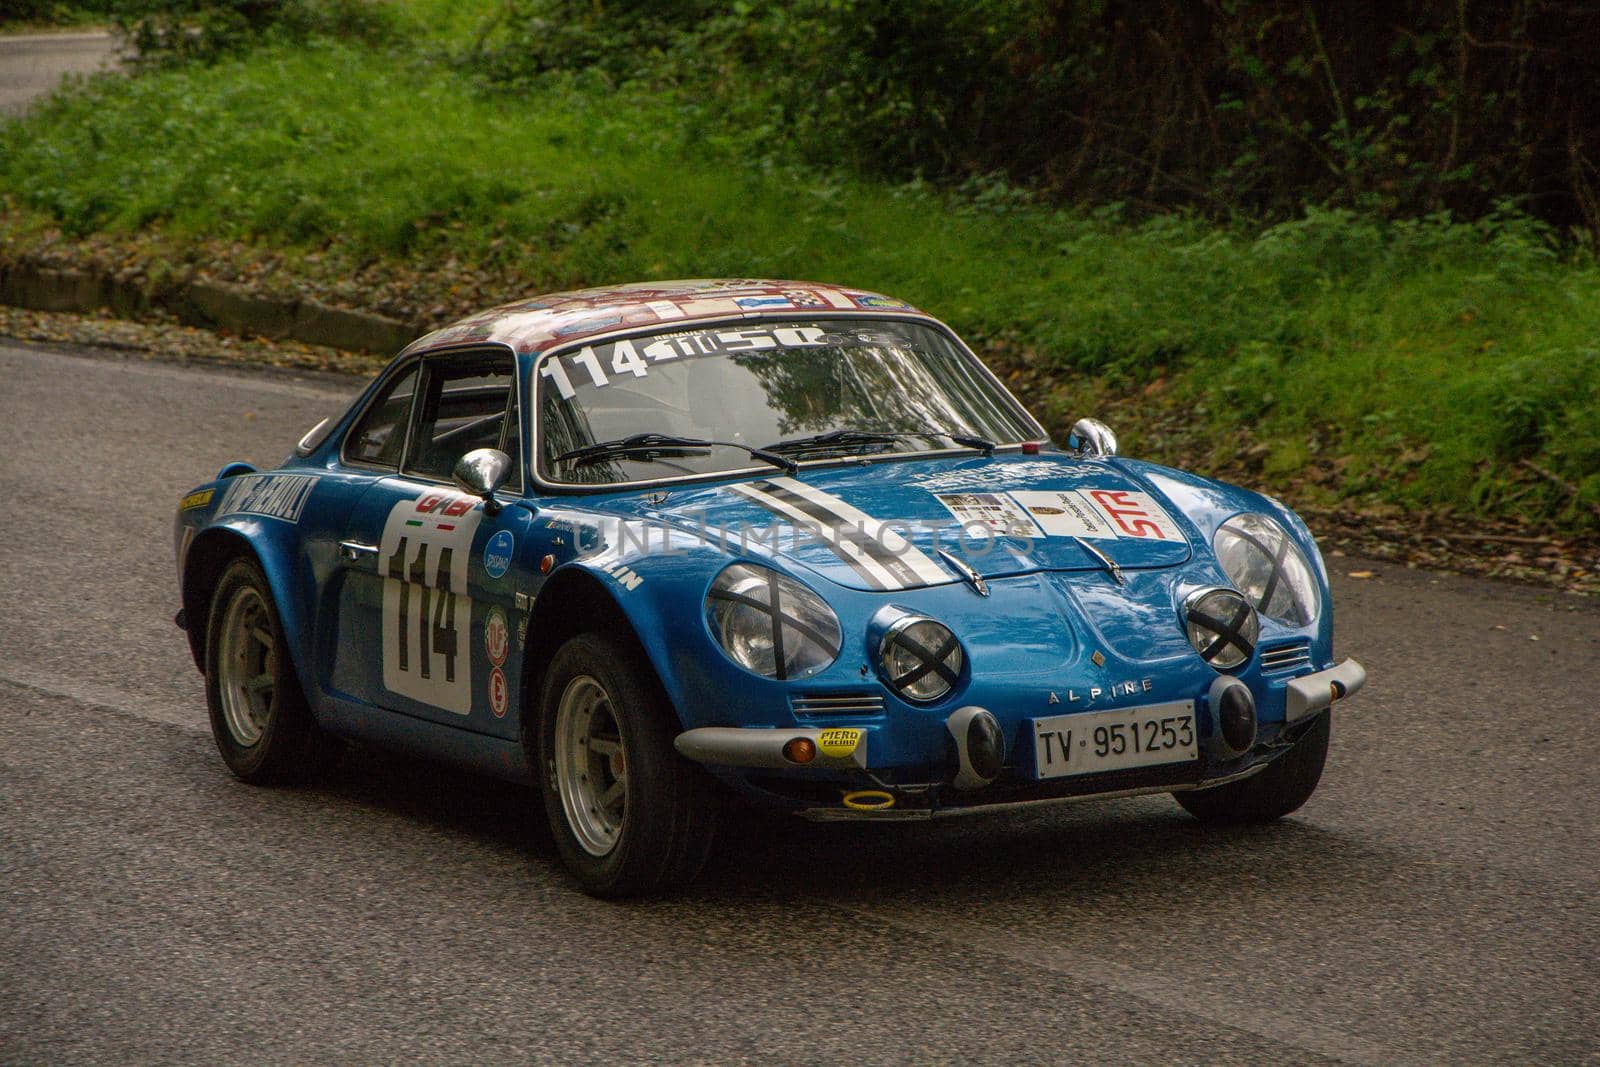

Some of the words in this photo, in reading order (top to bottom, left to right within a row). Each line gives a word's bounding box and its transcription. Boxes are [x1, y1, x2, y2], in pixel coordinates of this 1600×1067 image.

[654, 329, 707, 341] RENAULT
[540, 339, 648, 400] 114
[1089, 490, 1166, 539] STR
[389, 536, 458, 683] 114
[1048, 678, 1153, 705] ALPINE
[821, 730, 858, 740] PIERO
[1039, 730, 1072, 765] TV
[1093, 715, 1194, 758] 951253
